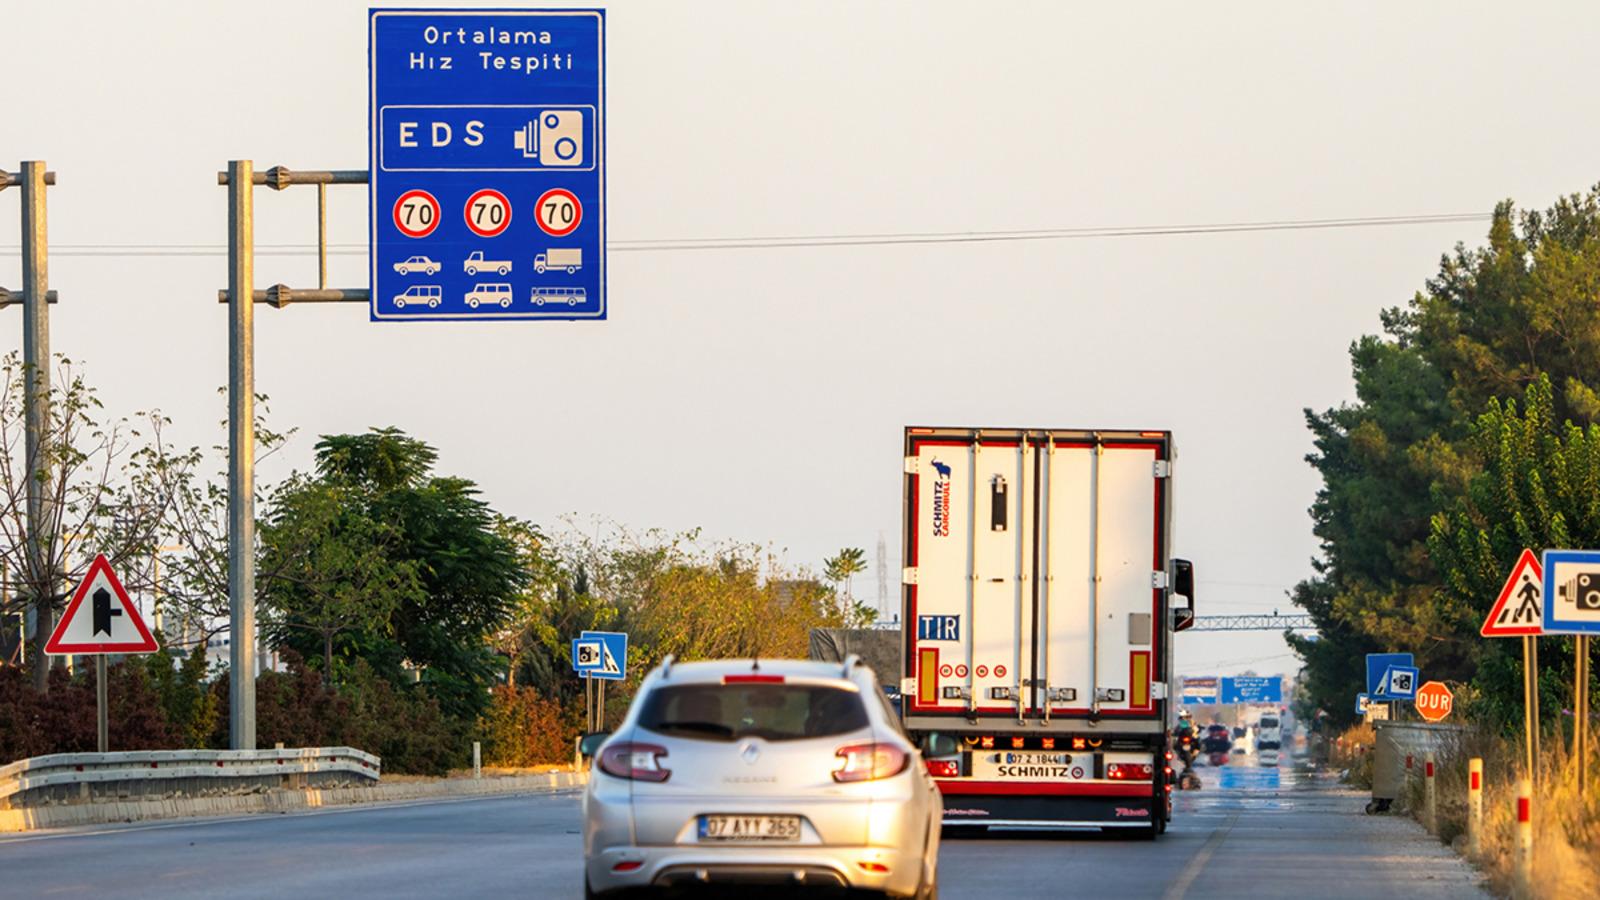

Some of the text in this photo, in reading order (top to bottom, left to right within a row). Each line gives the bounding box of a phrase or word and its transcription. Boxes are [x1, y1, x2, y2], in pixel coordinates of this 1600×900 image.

[424, 26, 551, 44] Ortalama
[410, 52, 572, 74] Hız Tespiti
[399, 120, 485, 147] EDS
[403, 203, 433, 225] 70
[474, 203, 503, 225] 70
[544, 202, 574, 224] 70
[933, 481, 943, 537] SCHMITZ
[942, 482, 951, 537] CARGOBULL
[921, 616, 957, 640] TIR
[1419, 692, 1449, 710] DUR
[1012, 754, 1022, 764] 07
[1026, 754, 1032, 764] Z
[998, 766, 1068, 777] SCHMITZ
[708, 818, 798, 835] 07 AYY 365
